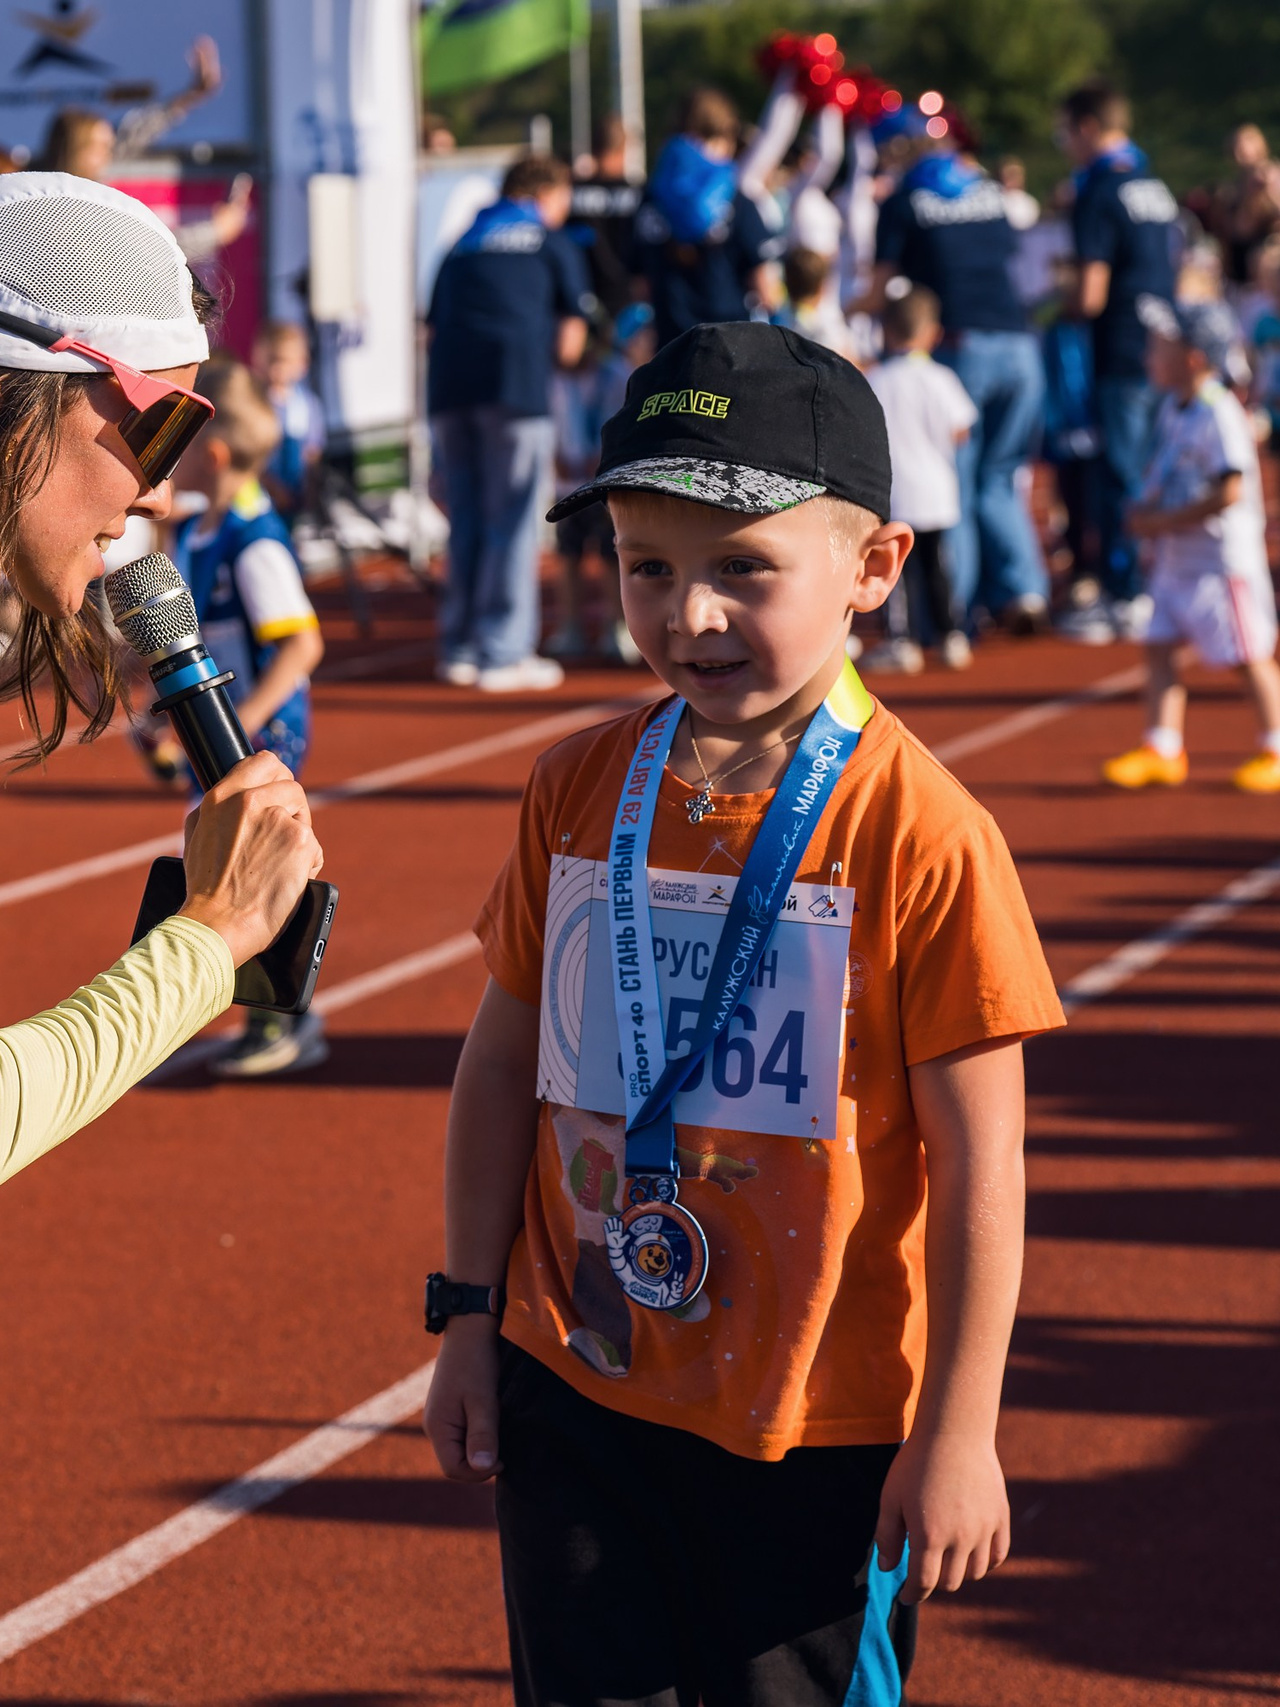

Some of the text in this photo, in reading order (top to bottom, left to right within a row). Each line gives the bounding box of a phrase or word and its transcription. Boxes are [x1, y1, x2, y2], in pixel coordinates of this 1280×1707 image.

[637, 389, 731, 421] SPACE
[653, 891, 697, 904] МАРАФОН
[713, 925, 761, 1031] КАЛУЖСКИЙ
[792, 736, 844, 816] МАРАФОН
[614, 718, 668, 1097] СПОРТ 40 СТАНЬ ПЕРВЫМ 29 АВГУСТА
[630, 1072, 639, 1098] PRO
